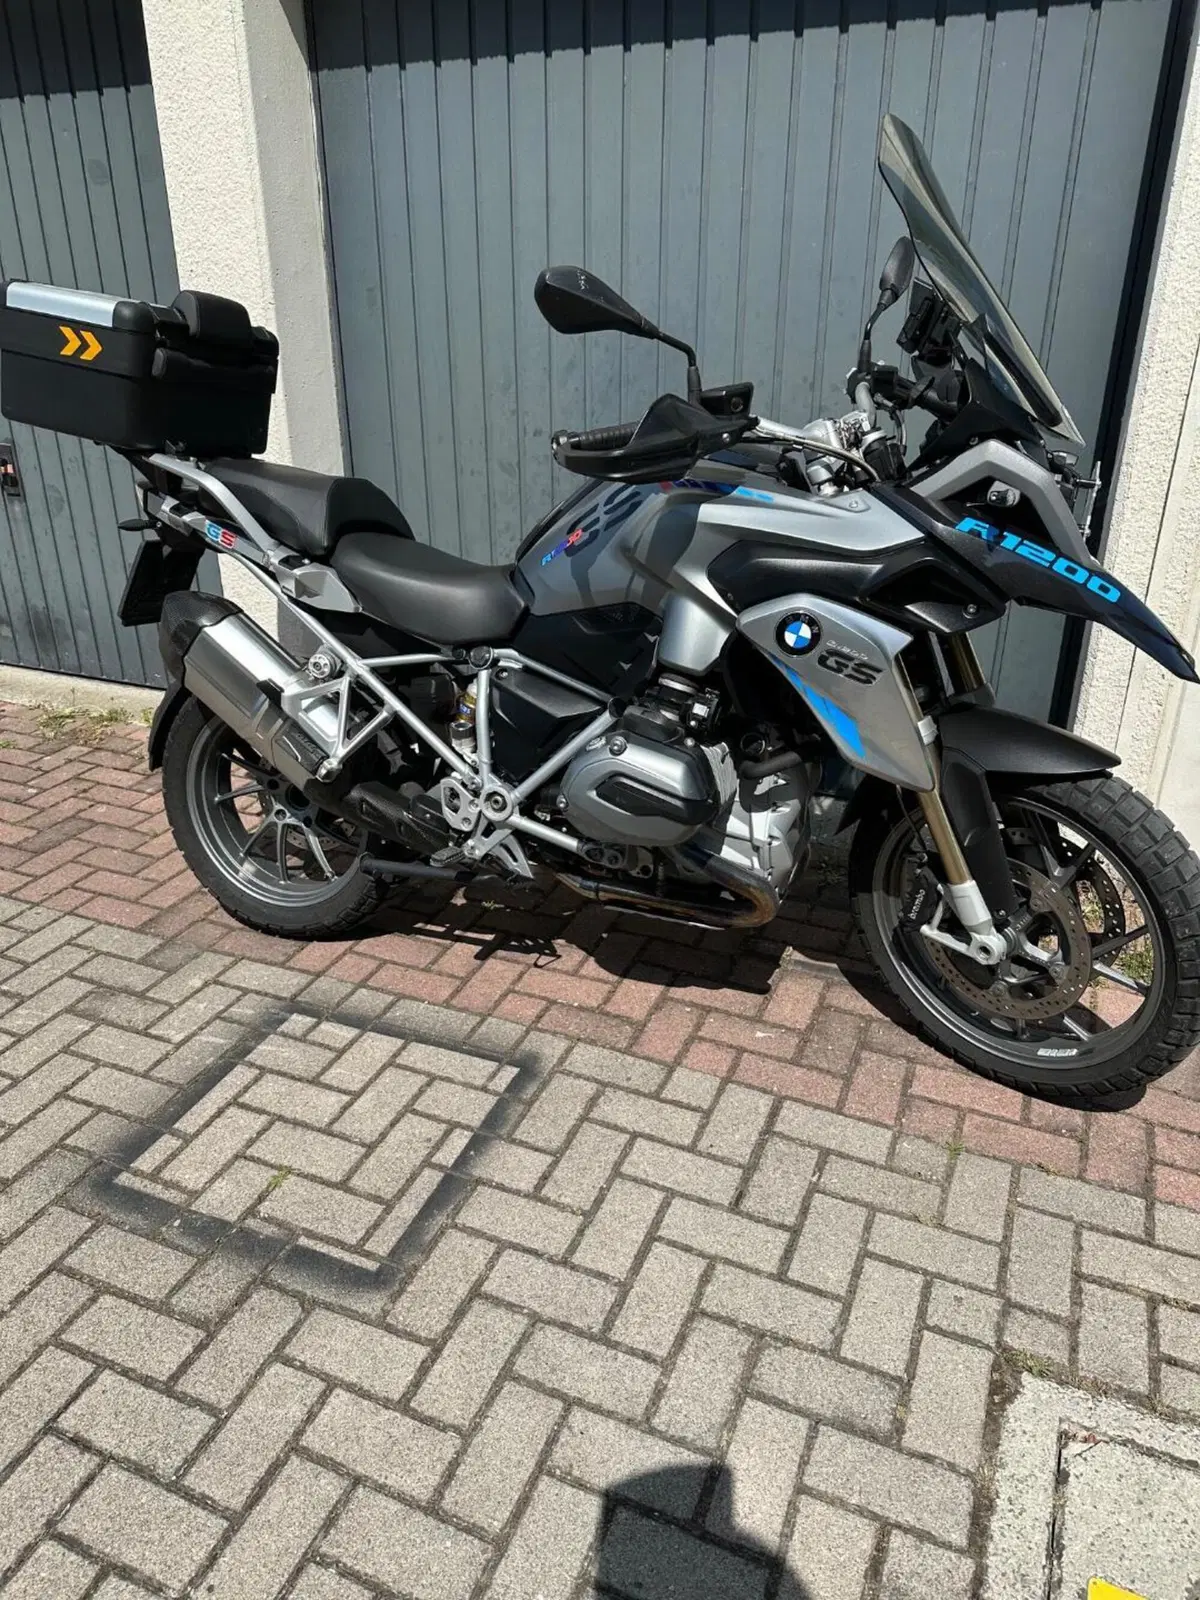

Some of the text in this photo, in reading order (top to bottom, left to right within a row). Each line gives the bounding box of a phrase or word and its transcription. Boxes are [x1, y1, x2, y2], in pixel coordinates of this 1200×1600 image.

[205, 520, 237, 548] GS
[564, 484, 643, 557] GS
[955, 517, 1121, 603] R1200
[817, 648, 883, 685] GS
[908, 889, 926, 920] brembo
